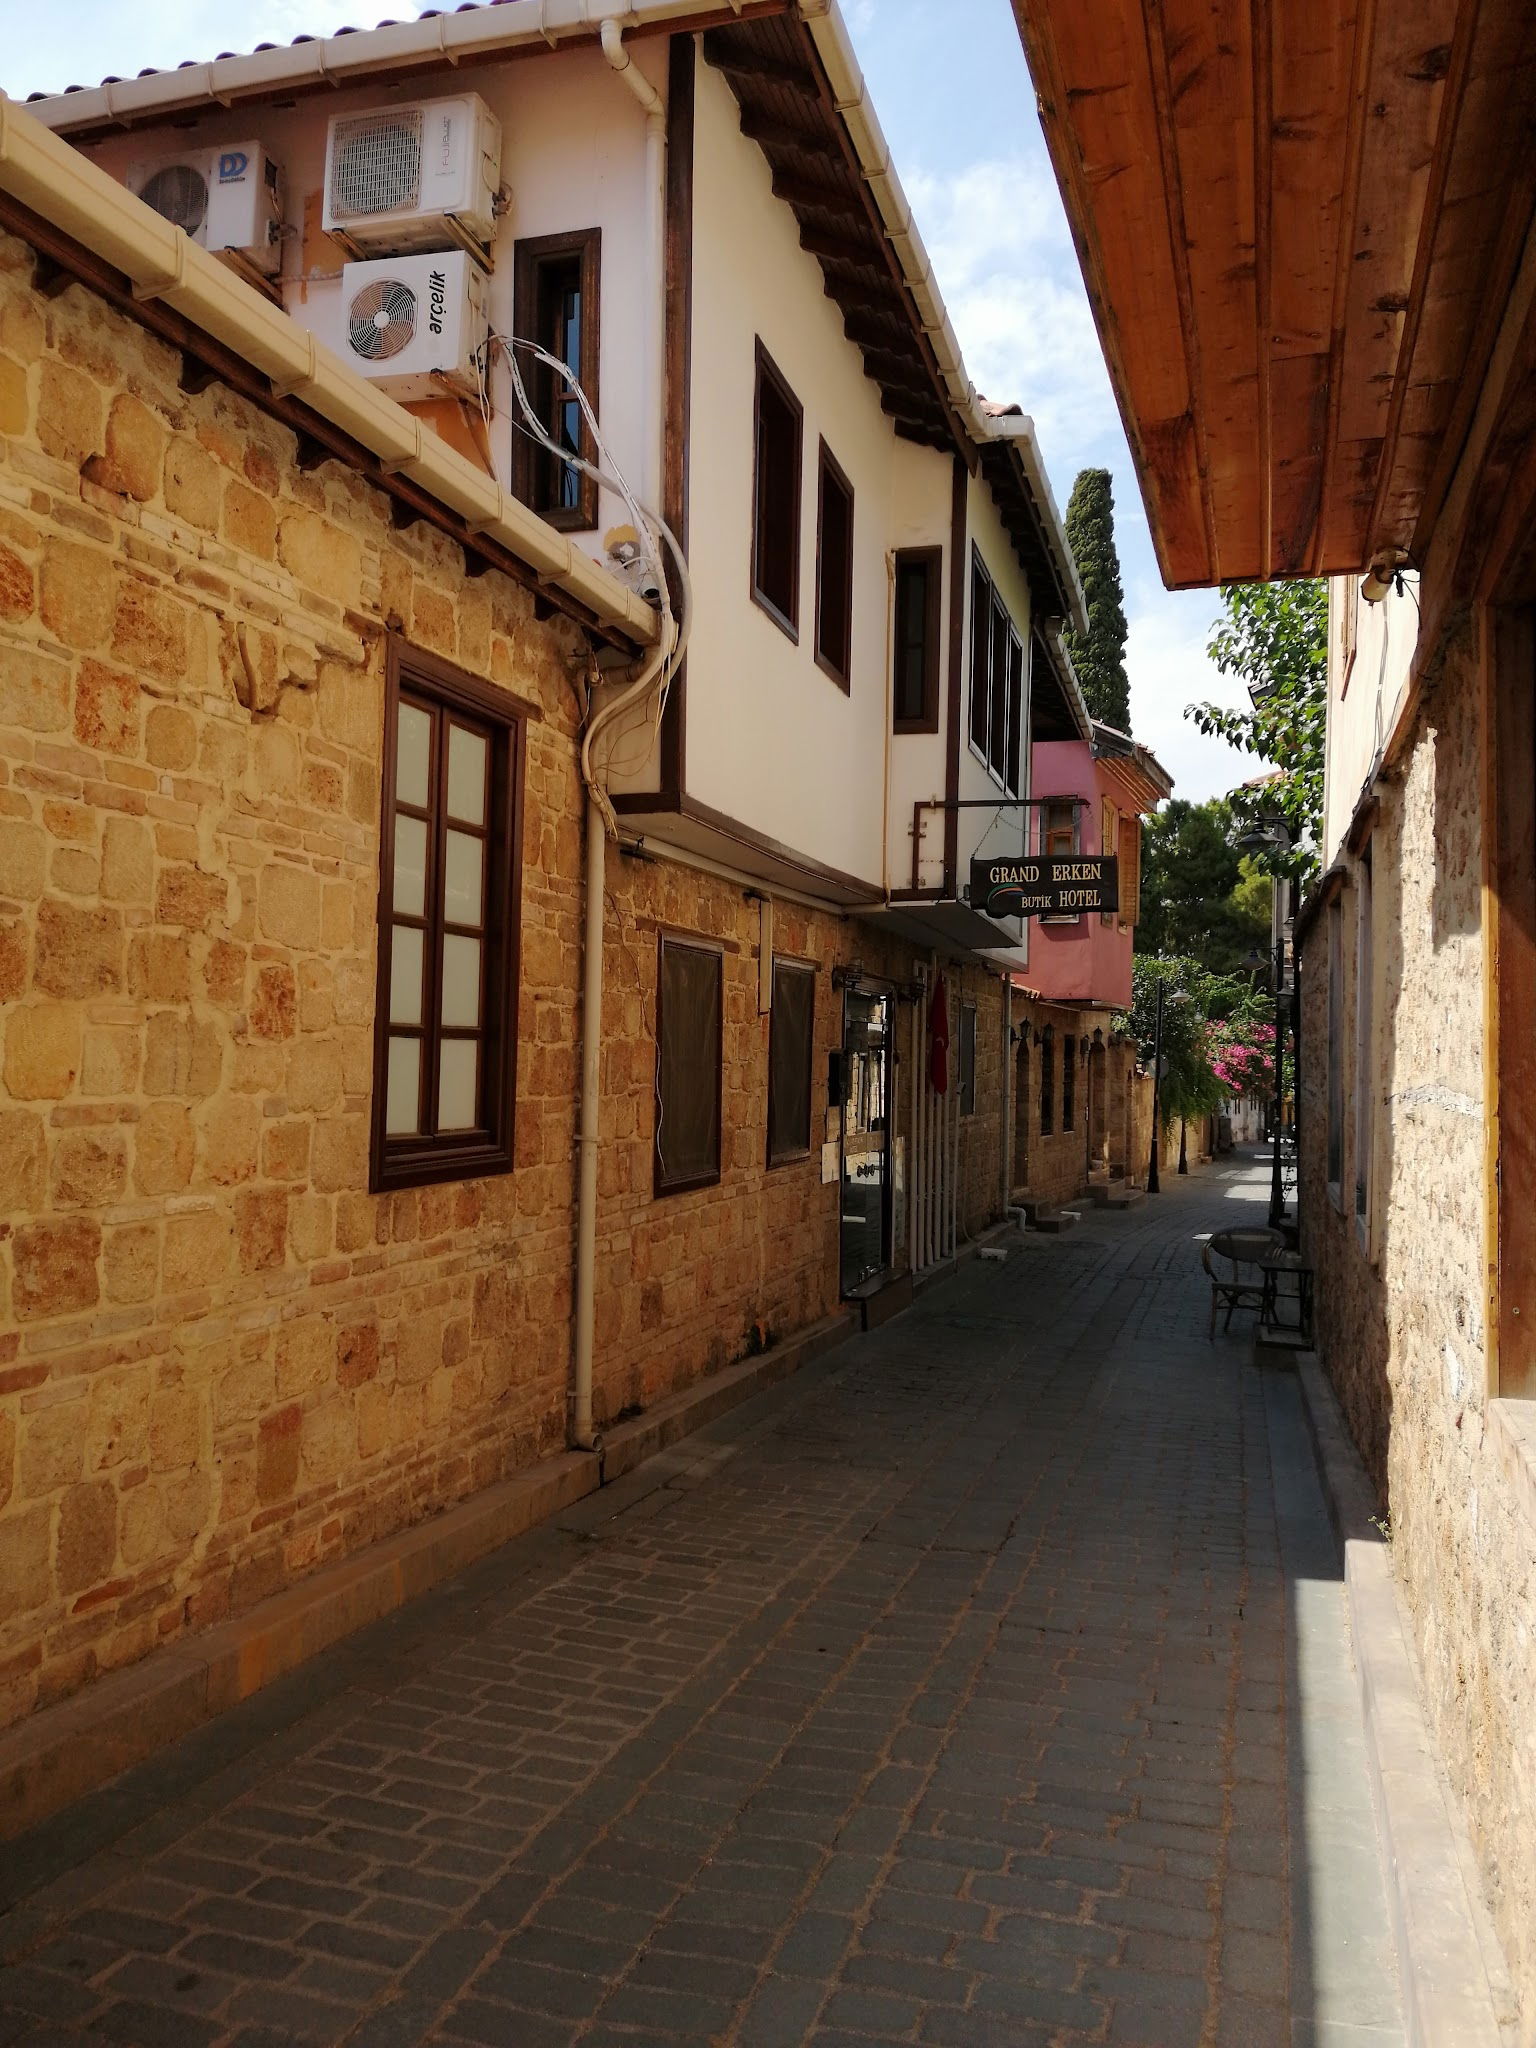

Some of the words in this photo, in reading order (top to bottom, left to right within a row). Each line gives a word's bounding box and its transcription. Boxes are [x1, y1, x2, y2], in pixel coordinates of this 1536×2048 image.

[429, 270, 447, 334] arçelik
[989, 865, 1040, 883] GRAND
[1051, 863, 1102, 881] ERKEN
[1059, 889, 1101, 907] HOTEL
